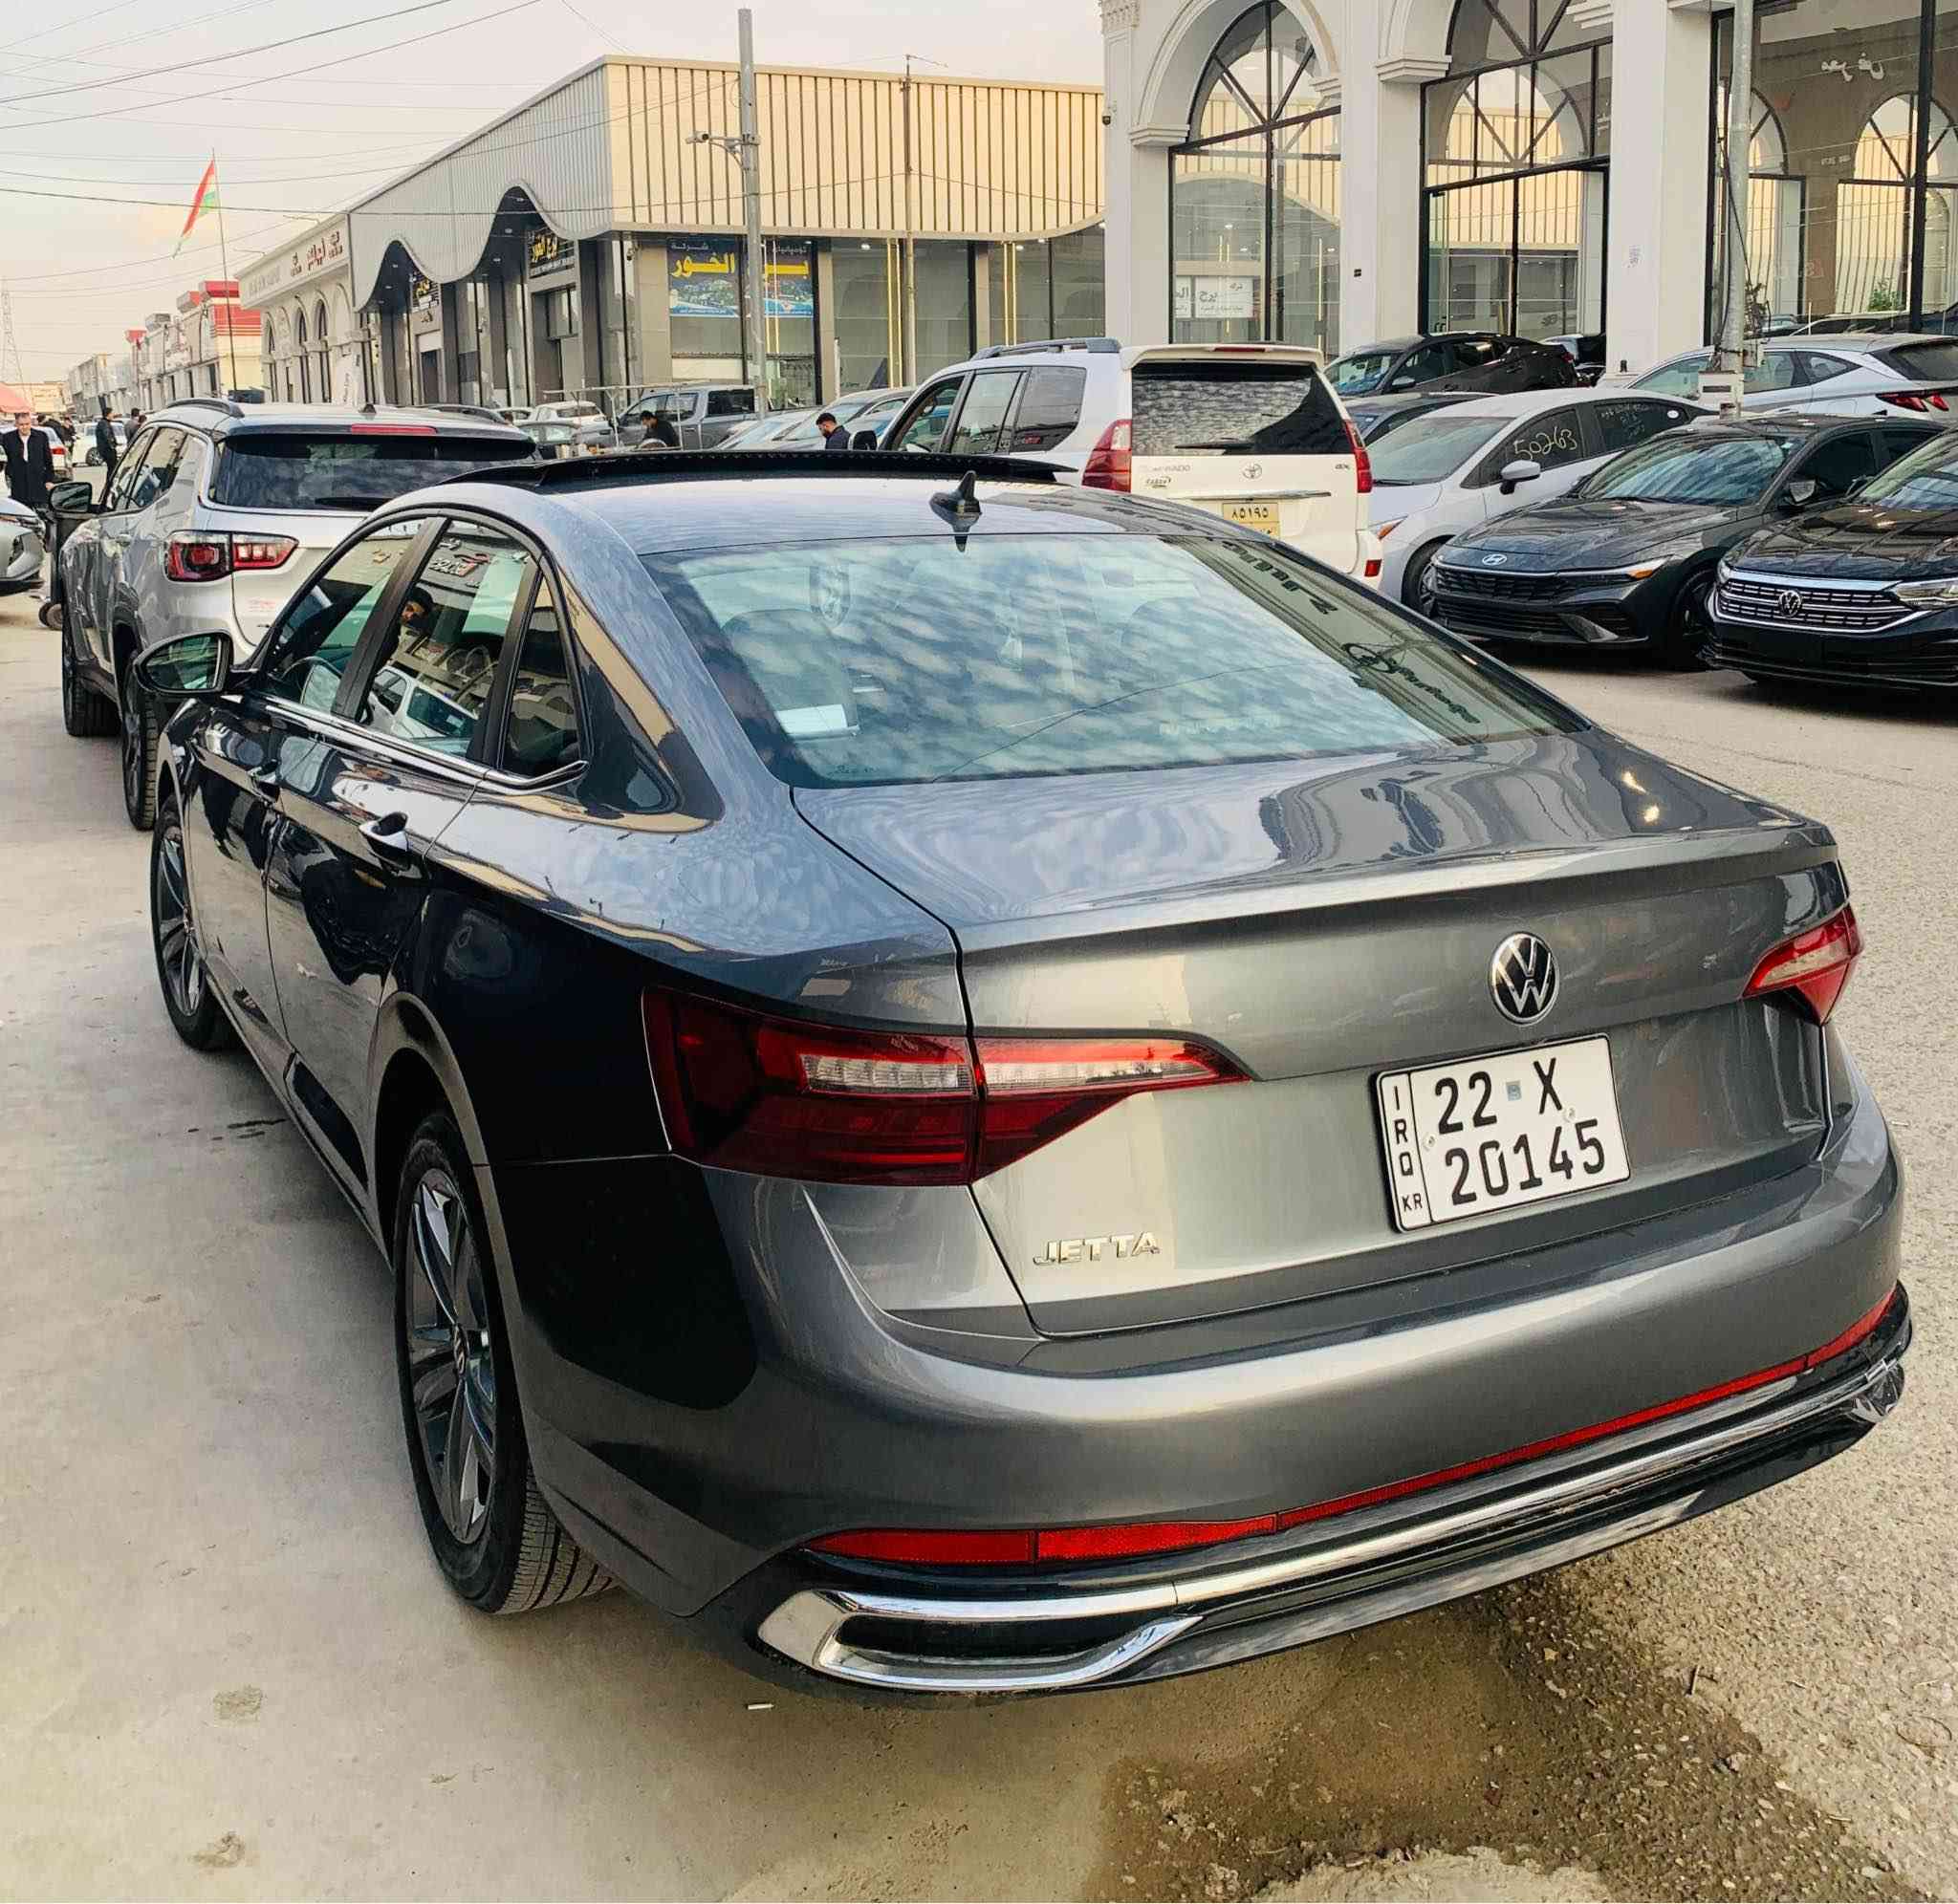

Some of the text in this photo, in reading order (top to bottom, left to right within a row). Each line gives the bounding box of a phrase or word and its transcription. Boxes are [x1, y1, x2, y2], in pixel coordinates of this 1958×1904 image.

[671, 252, 735, 277] الخور
[1513, 425, 1577, 460] 50263
[1231, 507, 1269, 519] ٨٥١٩٥
[1434, 1057, 1563, 1135] 22 X
[1393, 1085, 1413, 1177] IRQ
[1445, 1118, 1605, 1205] 20145
[1403, 1193, 1423, 1212] KR
[1033, 1231, 1160, 1266] JETTA
